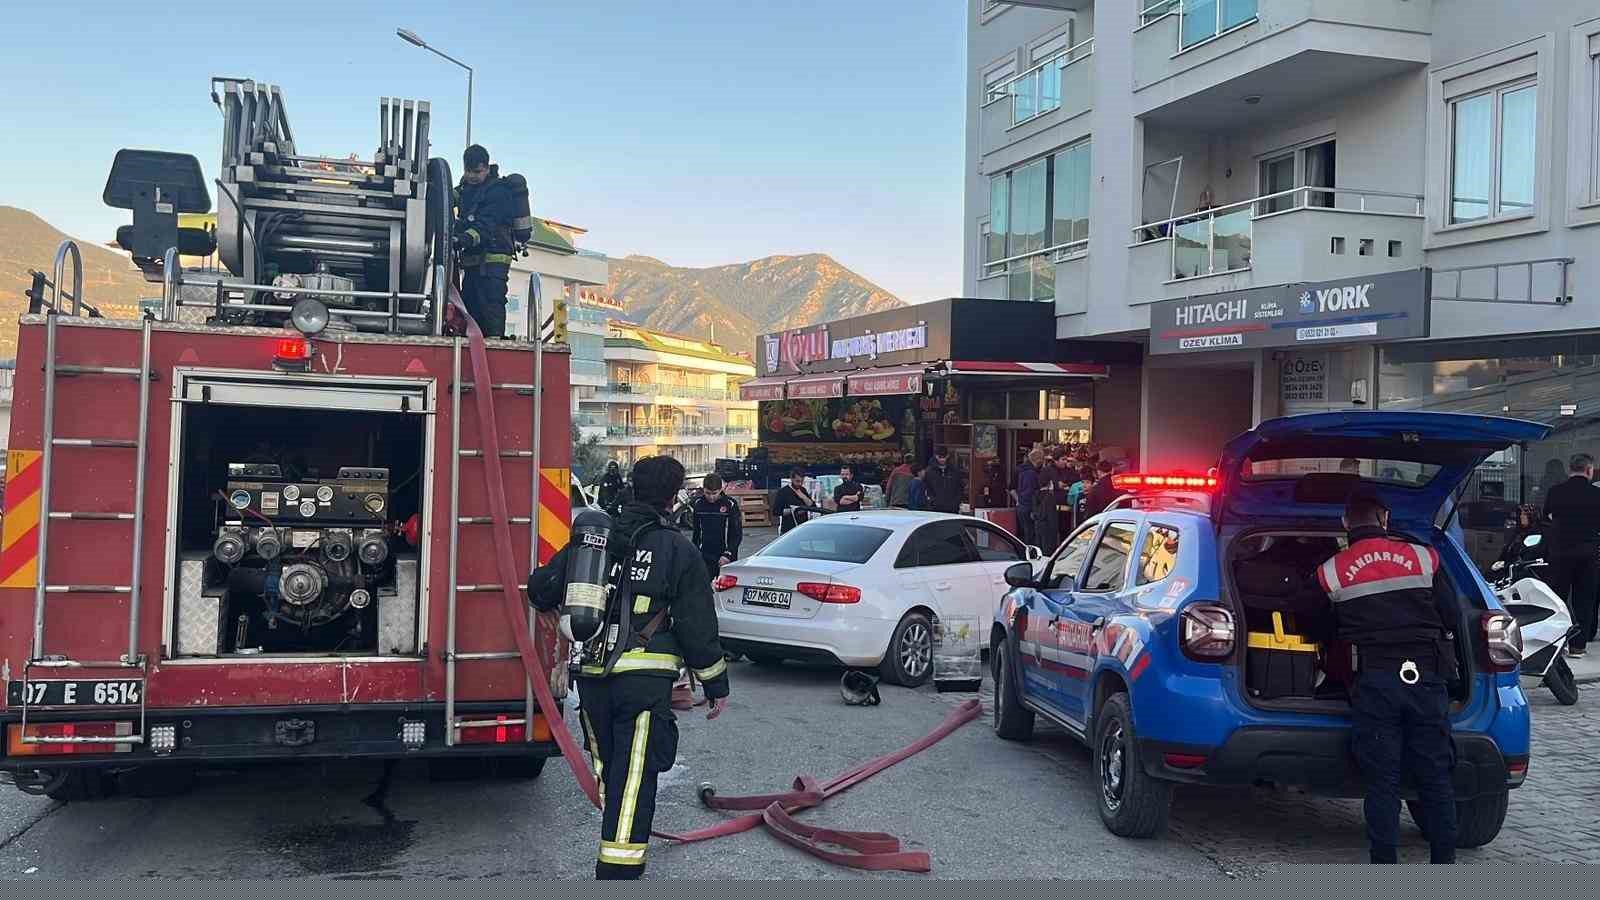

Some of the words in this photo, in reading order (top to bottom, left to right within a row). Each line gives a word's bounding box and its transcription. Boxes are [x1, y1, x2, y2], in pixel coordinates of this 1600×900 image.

[1316, 284, 1370, 312] YORK
[1176, 300, 1247, 325] HITACHI
[1346, 551, 1413, 581] JANDARMA
[747, 590, 757, 600] 07
[758, 591, 777, 603] MKG
[779, 592, 789, 604] 04
[22, 683, 47, 704] 07
[64, 683, 77, 704] E
[94, 682, 138, 704] 6514
